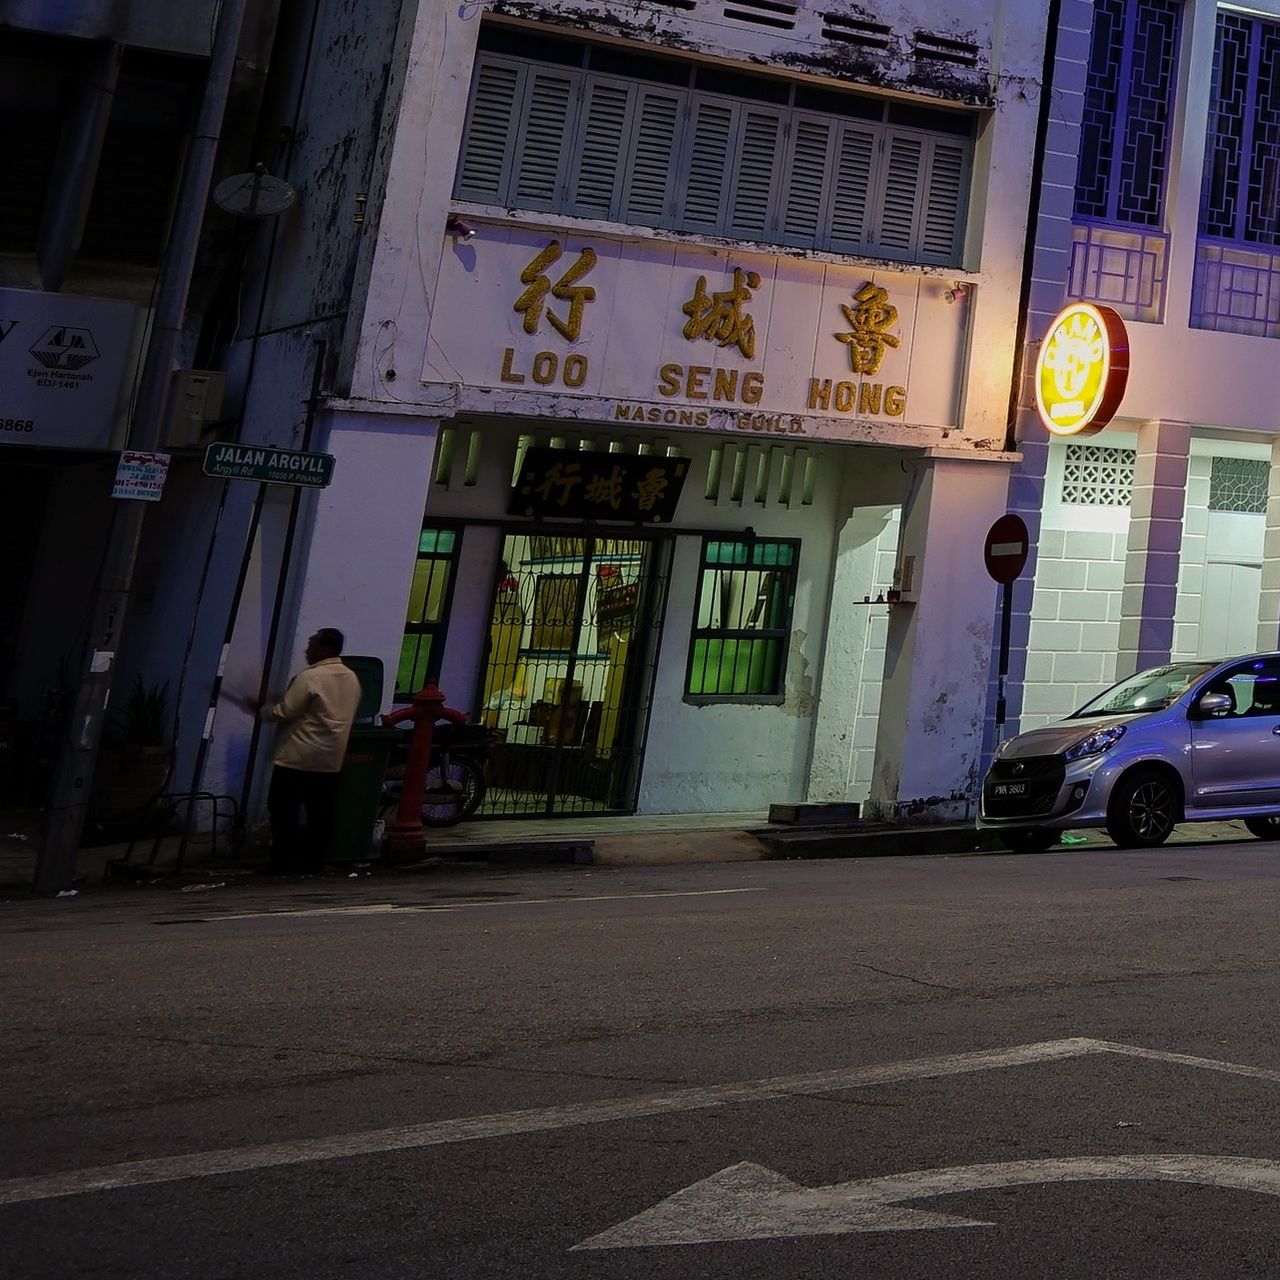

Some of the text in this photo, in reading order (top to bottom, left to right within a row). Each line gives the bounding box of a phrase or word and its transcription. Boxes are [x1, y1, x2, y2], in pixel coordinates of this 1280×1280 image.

[501, 347, 907, 417] LOO SENG HONG
[615, 404, 709, 427] MASONS
[212, 463, 255, 477] Argyll Rd
[215, 447, 325, 473] JALAN ARGYLL
[295, 473, 322, 483] PINANG
